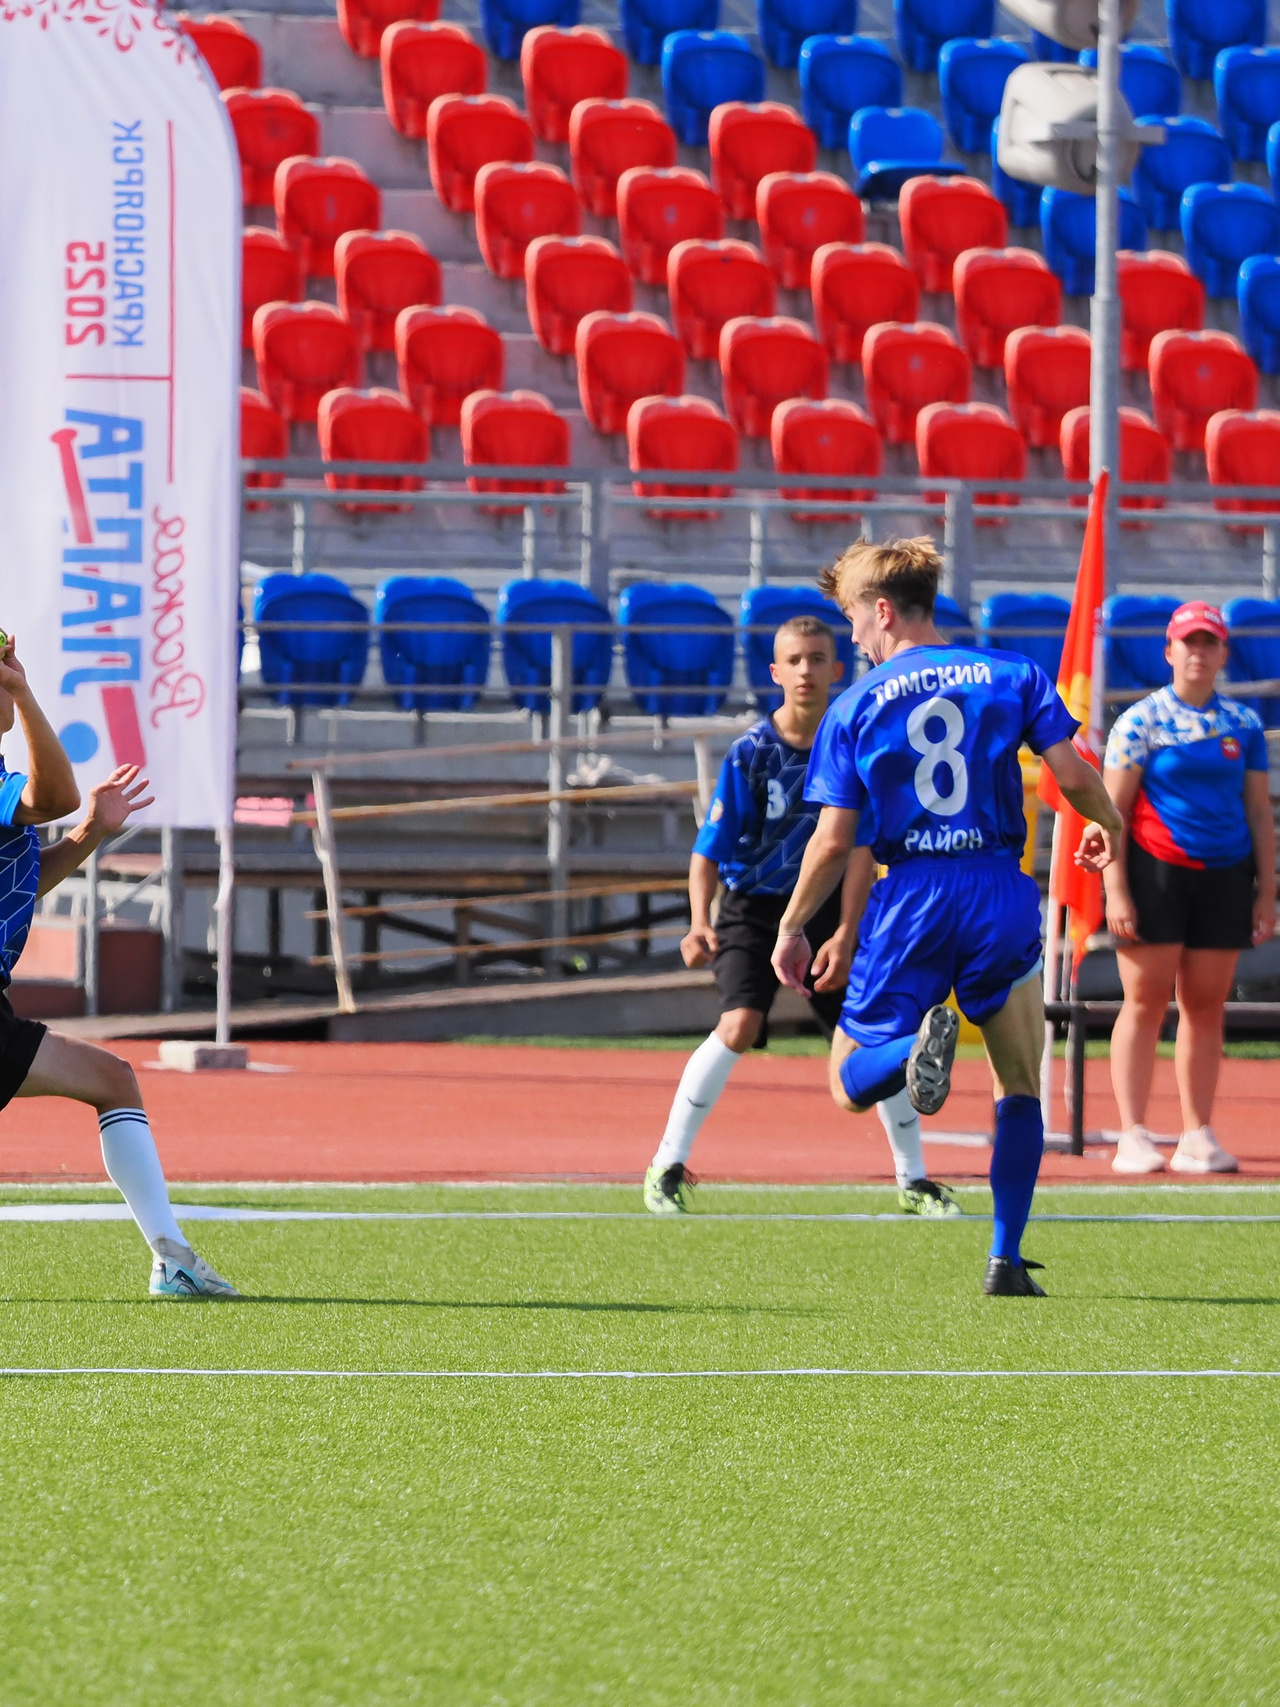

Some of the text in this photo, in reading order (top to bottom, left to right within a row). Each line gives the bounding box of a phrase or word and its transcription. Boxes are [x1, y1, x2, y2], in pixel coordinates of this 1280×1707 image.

[869, 662, 992, 706] ТОМСКИЙ
[906, 696, 969, 817] 8
[904, 824, 984, 853] РАЙОН
